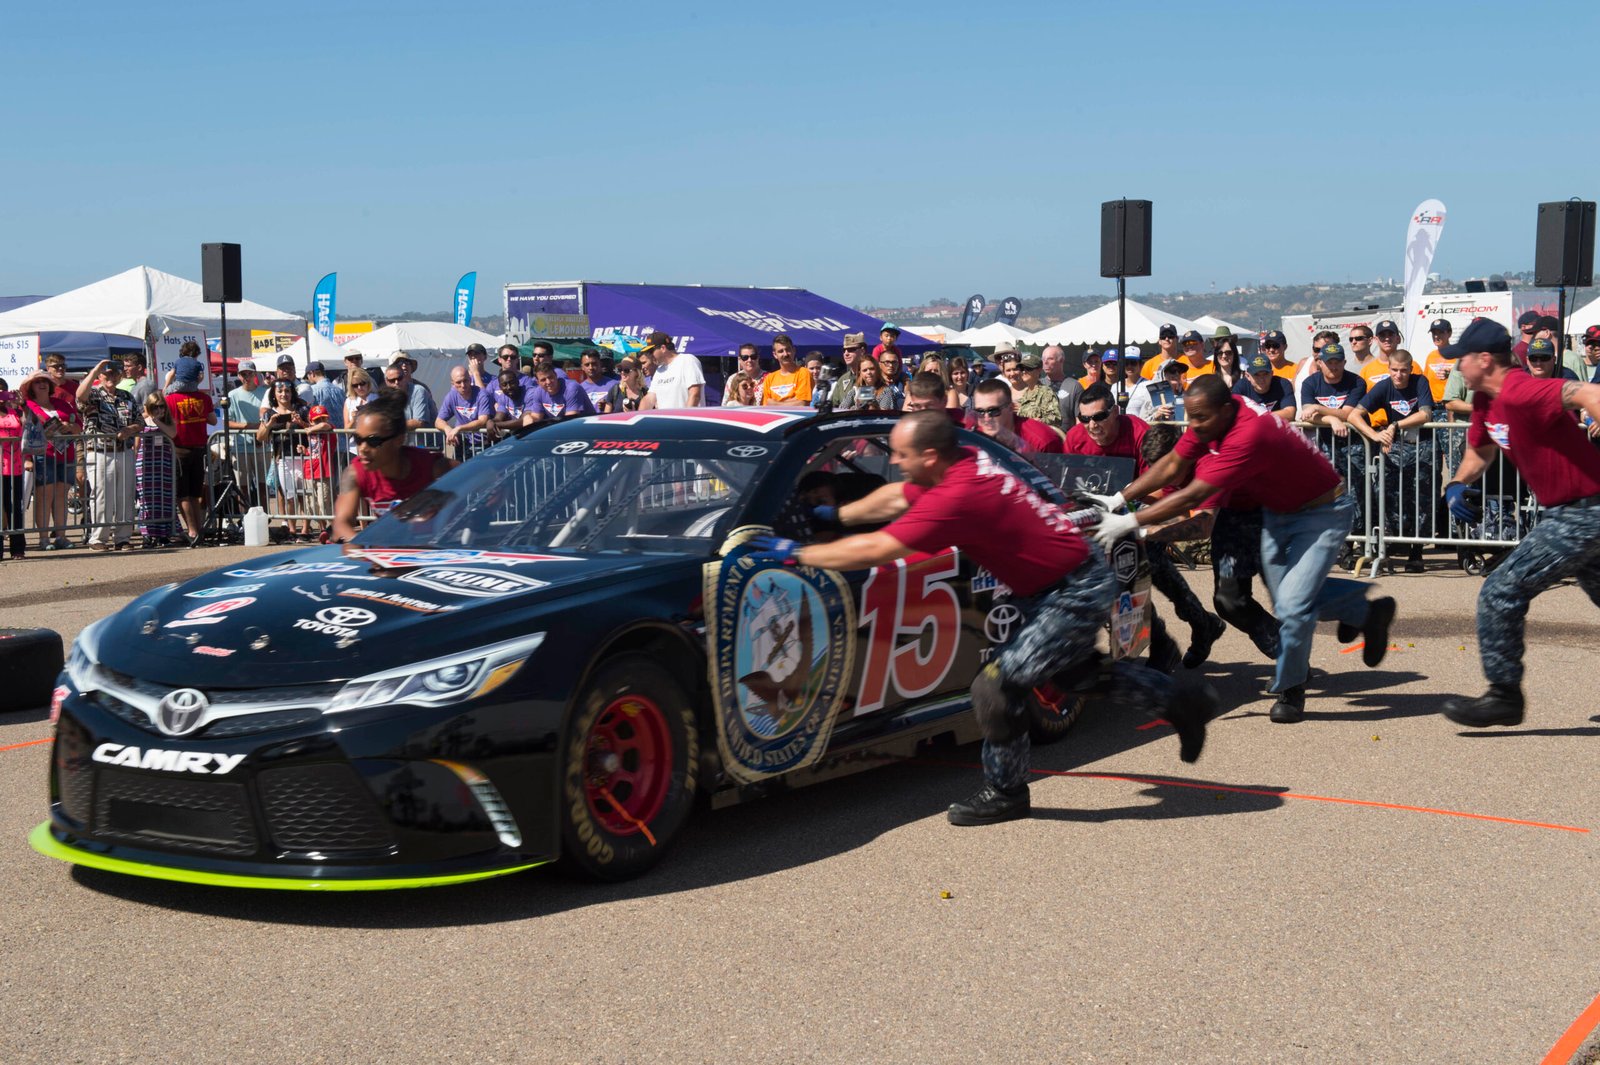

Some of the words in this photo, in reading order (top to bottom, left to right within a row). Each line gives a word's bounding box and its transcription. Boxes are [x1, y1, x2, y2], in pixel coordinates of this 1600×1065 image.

[1427, 305, 1499, 316] RACEROOM
[550, 325, 589, 335] LEMONADE
[16, 340, 29, 350] $15
[162, 335, 181, 345] Hats
[10, 353, 17, 364] &
[594, 441, 660, 450] TOYOTA
[292, 618, 360, 638] TOYOTA
[721, 564, 744, 698] DEPARTMENT
[853, 546, 960, 717] 15
[91, 742, 248, 775] CAMRY
